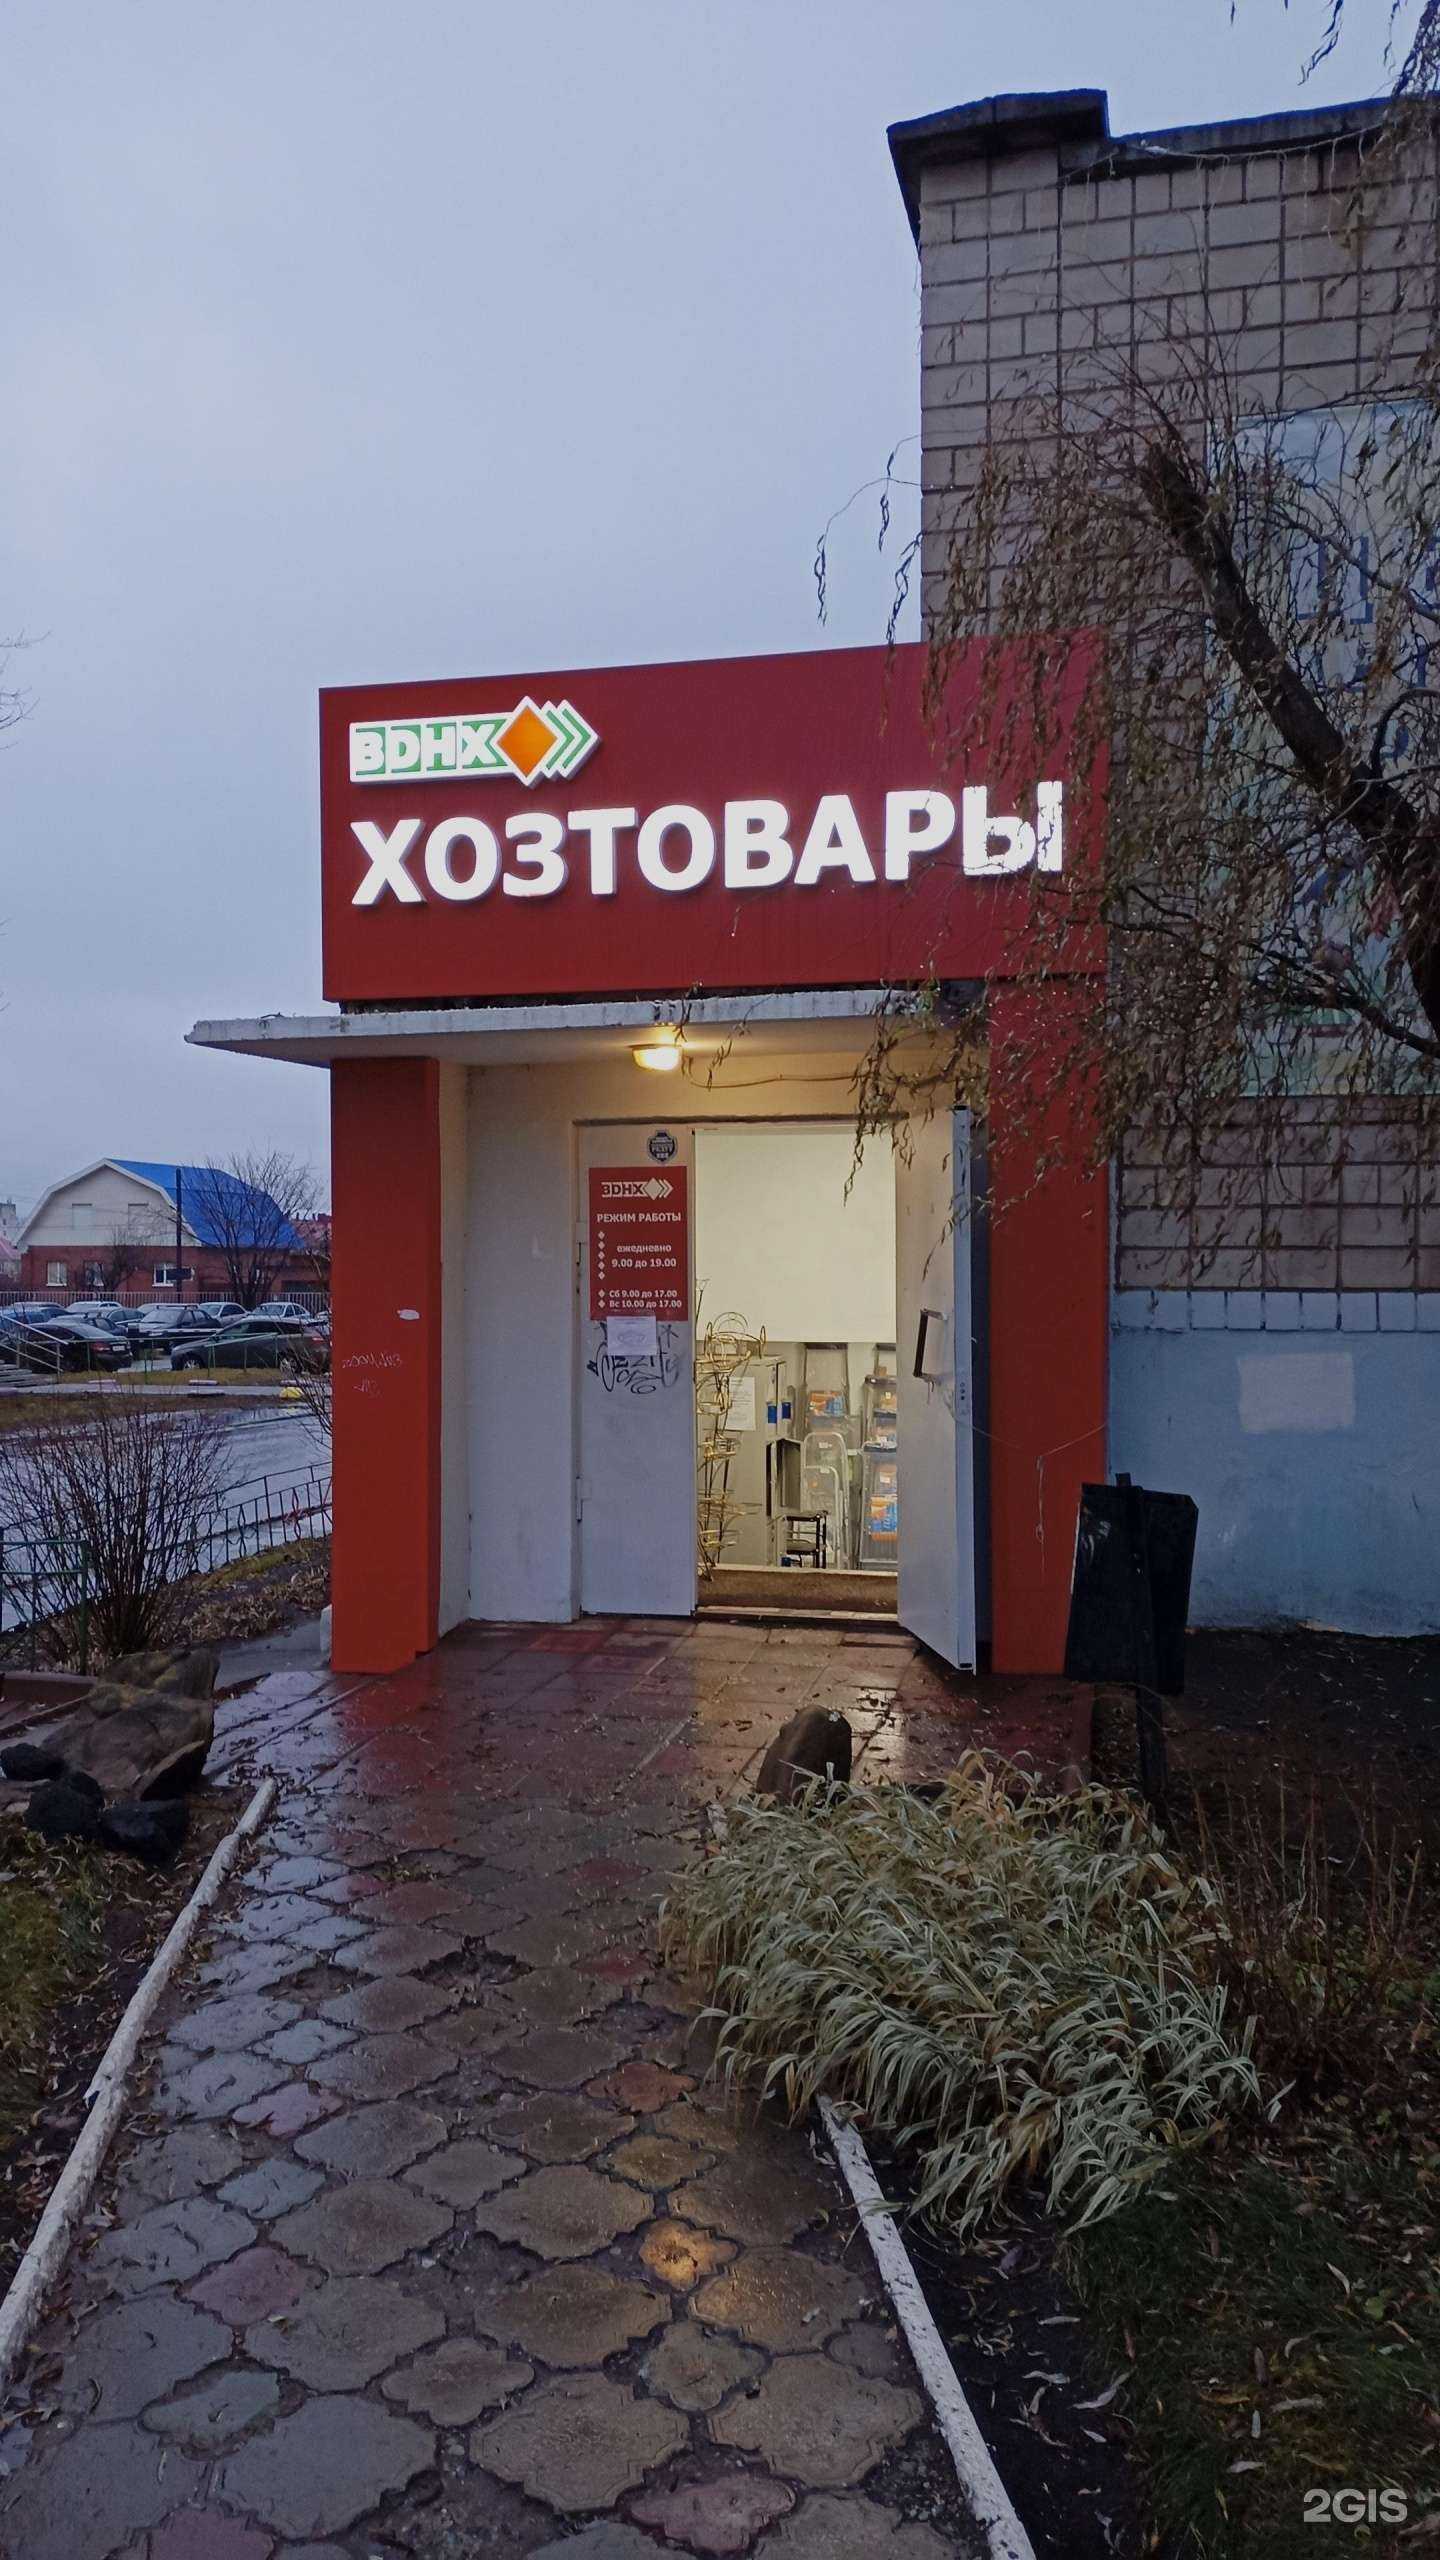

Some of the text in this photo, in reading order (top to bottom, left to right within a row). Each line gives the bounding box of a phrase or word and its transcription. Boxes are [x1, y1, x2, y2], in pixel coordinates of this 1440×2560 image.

[350, 781, 1064, 905] ХОЗТОВАРЫ
[596, 1212, 682, 1223] РЕЖИМ РАБОТЫ
[616, 1243, 672, 1254] ежедневно
[611, 1258, 677, 1268] 9.00 до 19.00
[609, 1289, 678, 1299] Сб 9.00 до 17.00
[609, 1300, 682, 1309] Вс 10.00 до 17.00
